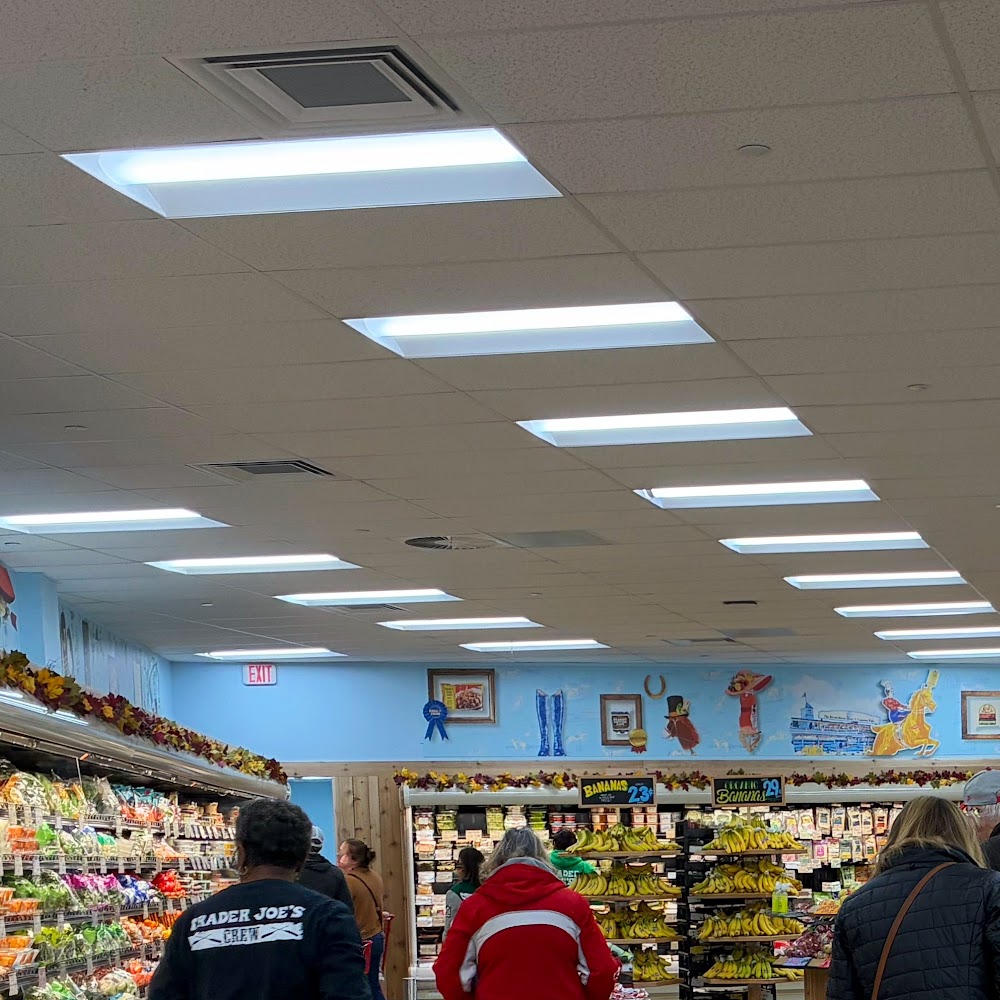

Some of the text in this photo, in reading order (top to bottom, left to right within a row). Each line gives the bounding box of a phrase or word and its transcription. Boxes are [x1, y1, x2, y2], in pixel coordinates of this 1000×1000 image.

[248, 665, 272, 682] EXIT
[583, 780, 628, 798] BANANAS
[716, 789, 767, 803] Bananas
[190, 905, 306, 931] TRADER JOE'S
[224, 926, 260, 943] CREW
